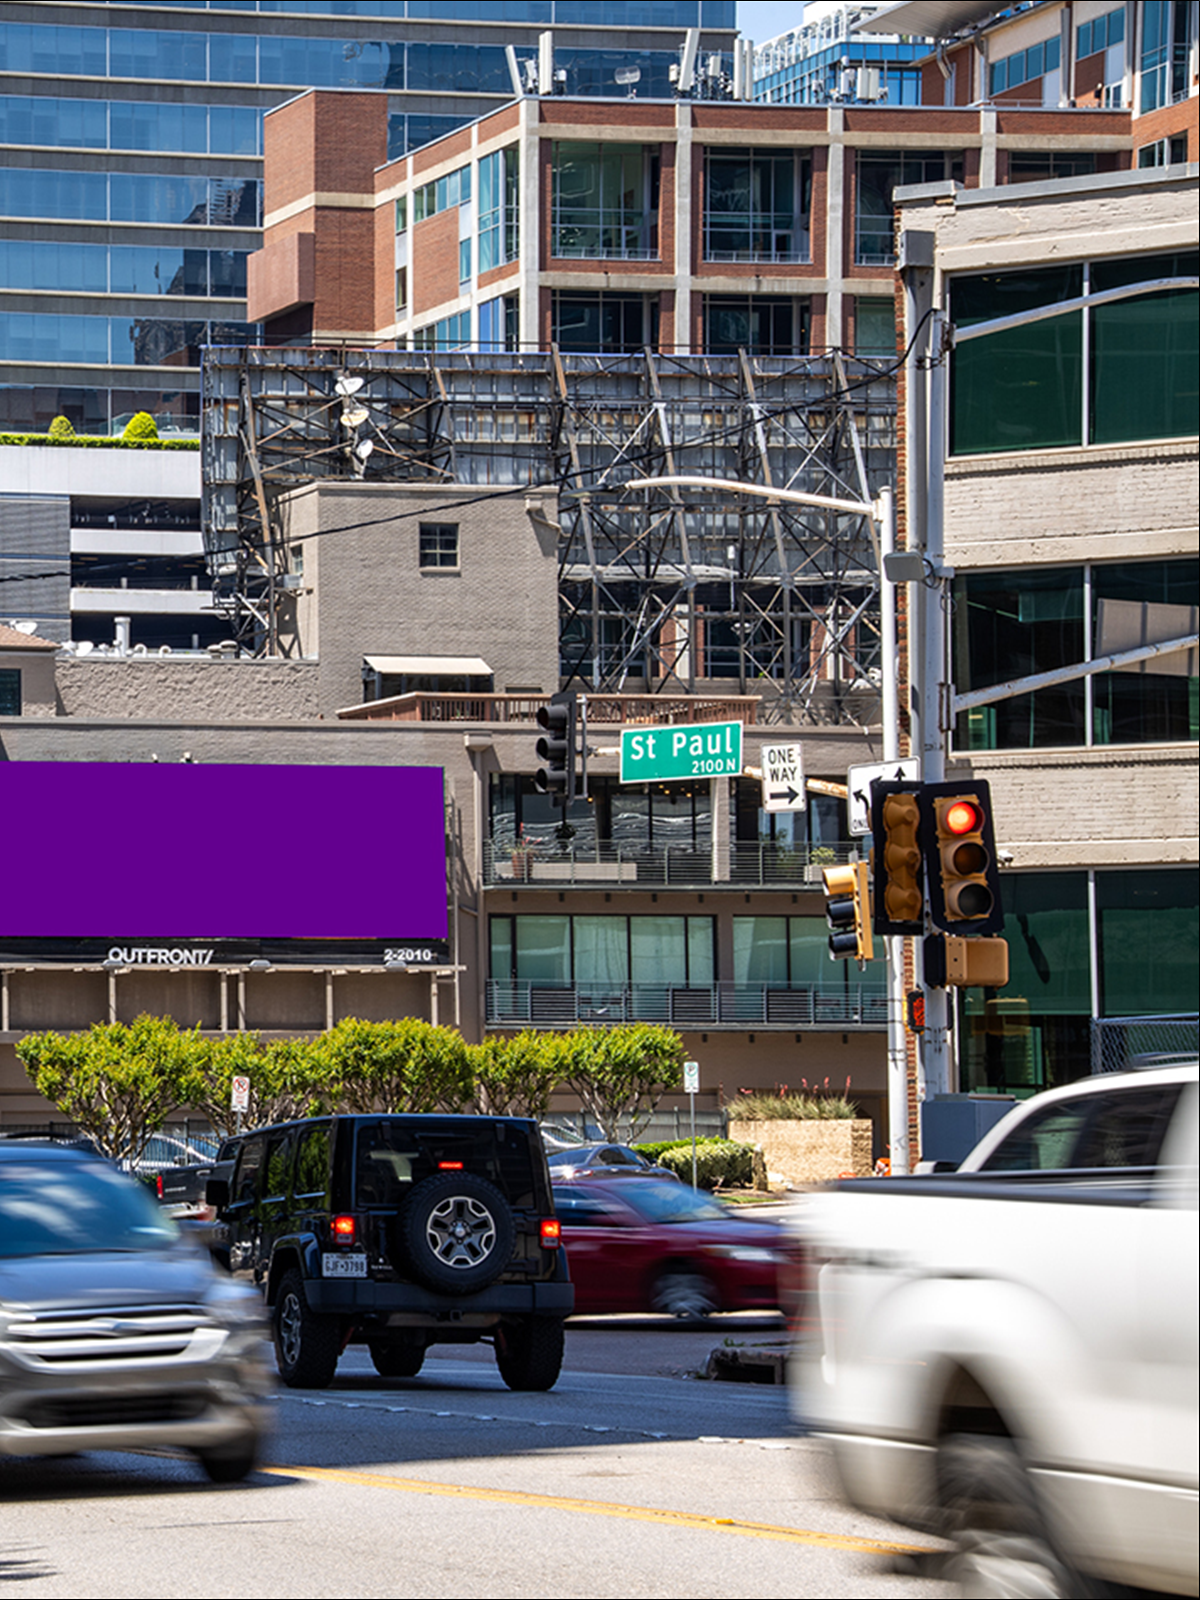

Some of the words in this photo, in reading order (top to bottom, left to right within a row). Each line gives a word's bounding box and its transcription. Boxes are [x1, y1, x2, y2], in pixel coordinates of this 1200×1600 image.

[630, 734, 656, 760] St
[672, 727, 733, 757] Paul
[768, 748, 796, 765] ONE
[692, 759, 724, 774] 2100
[726, 758, 736, 772] N
[769, 766, 798, 782] WAY
[384, 948, 432, 961] 2-2010
